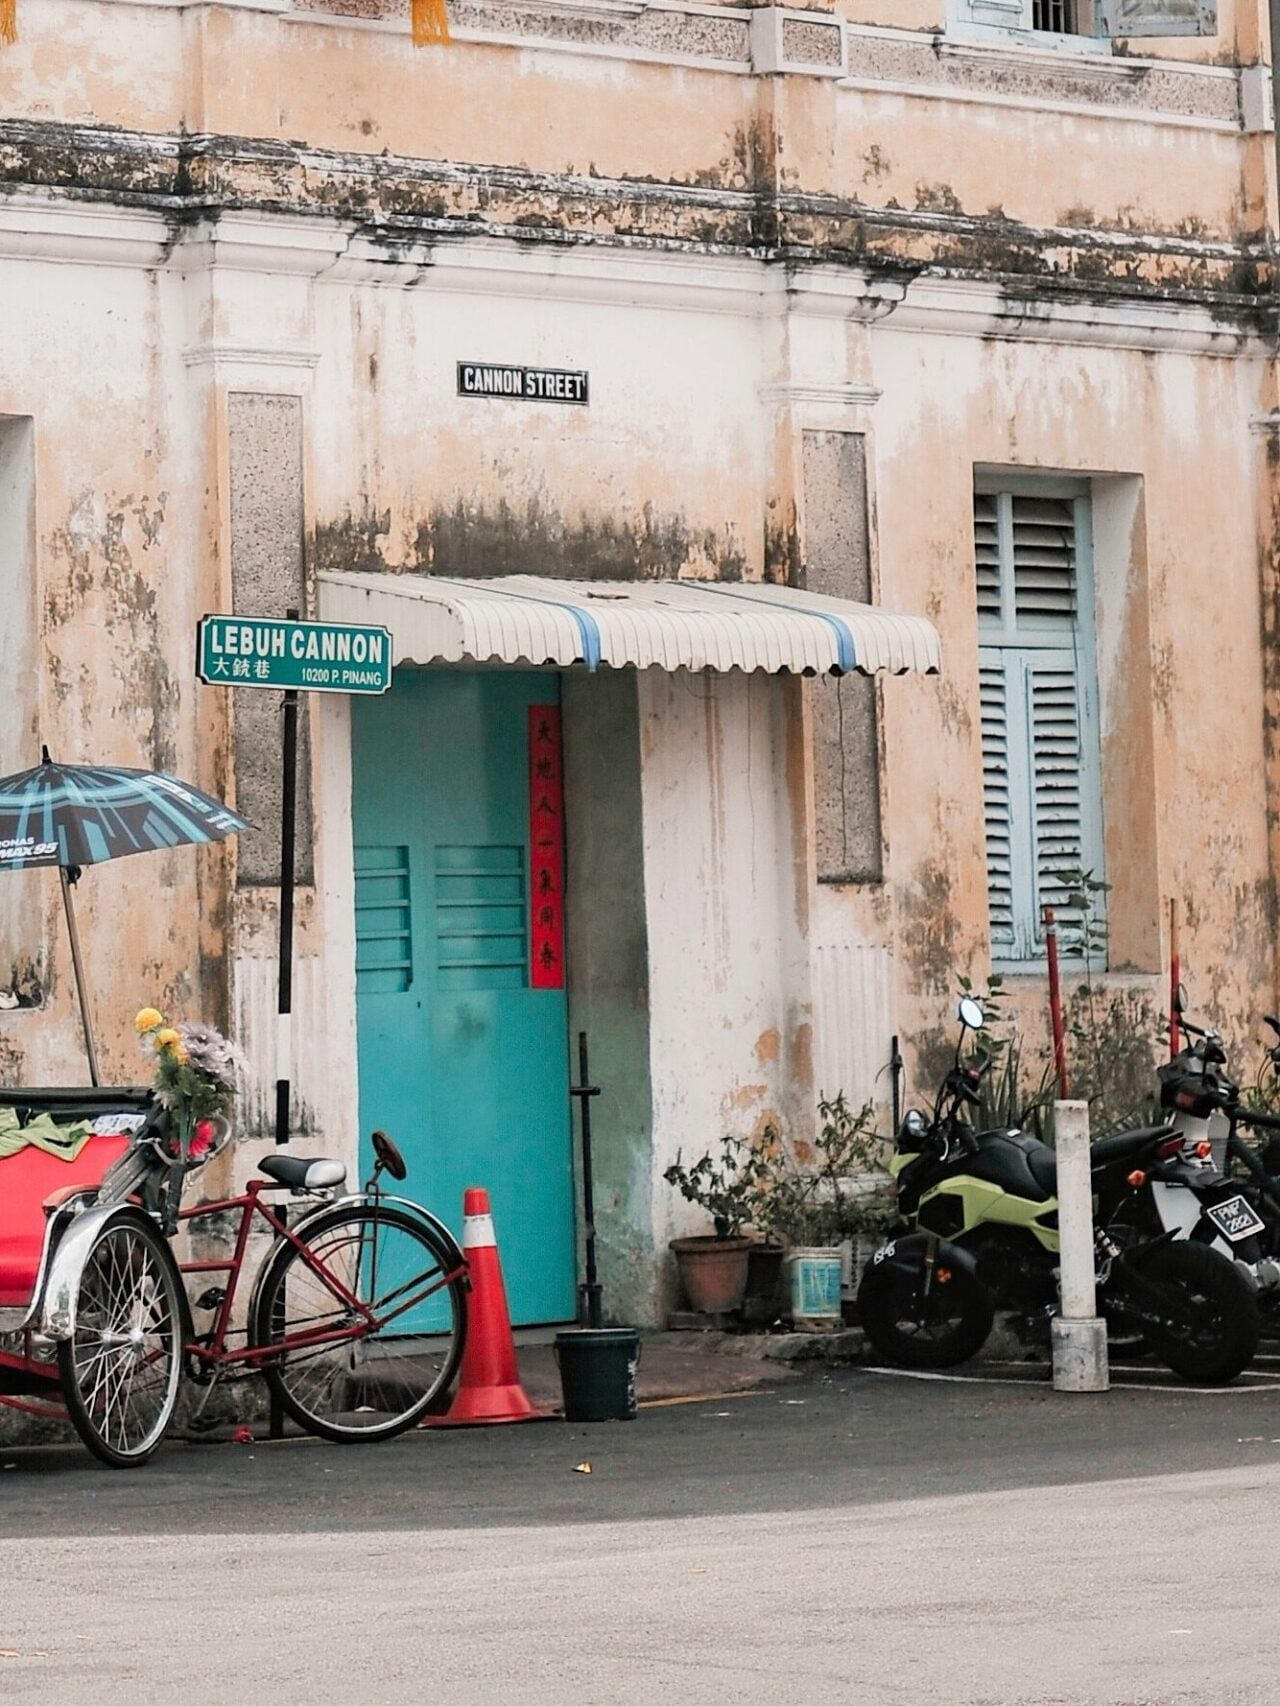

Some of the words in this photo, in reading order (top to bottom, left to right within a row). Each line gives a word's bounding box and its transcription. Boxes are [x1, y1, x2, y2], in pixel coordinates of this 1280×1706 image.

[464, 367, 521, 394] CANNON
[526, 372, 583, 399] STREET
[212, 624, 285, 658] LEBUH
[290, 629, 382, 664] CANNON
[301, 668, 329, 682] 10200
[331, 669, 340, 683] P.
[342, 670, 381, 685] PINANG
